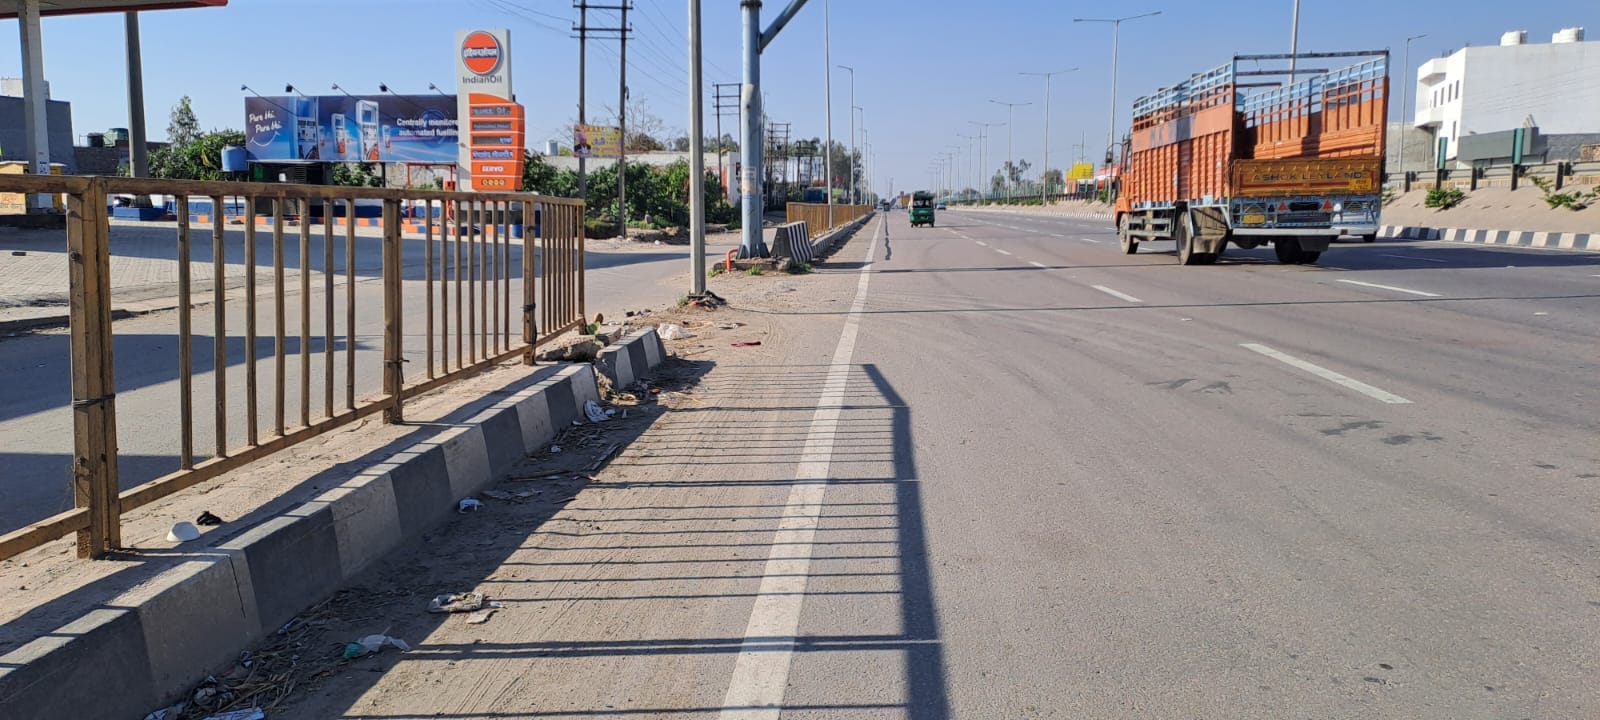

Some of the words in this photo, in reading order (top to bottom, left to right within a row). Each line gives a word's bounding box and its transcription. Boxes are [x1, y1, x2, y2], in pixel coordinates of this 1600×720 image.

[462, 75, 503, 84] IndianOil
[396, 118, 427, 128] Centrally
[482, 165, 504, 173] SERVO
[1252, 174, 1297, 182] ASHOK
[1302, 172, 1362, 180] LEYLAND
